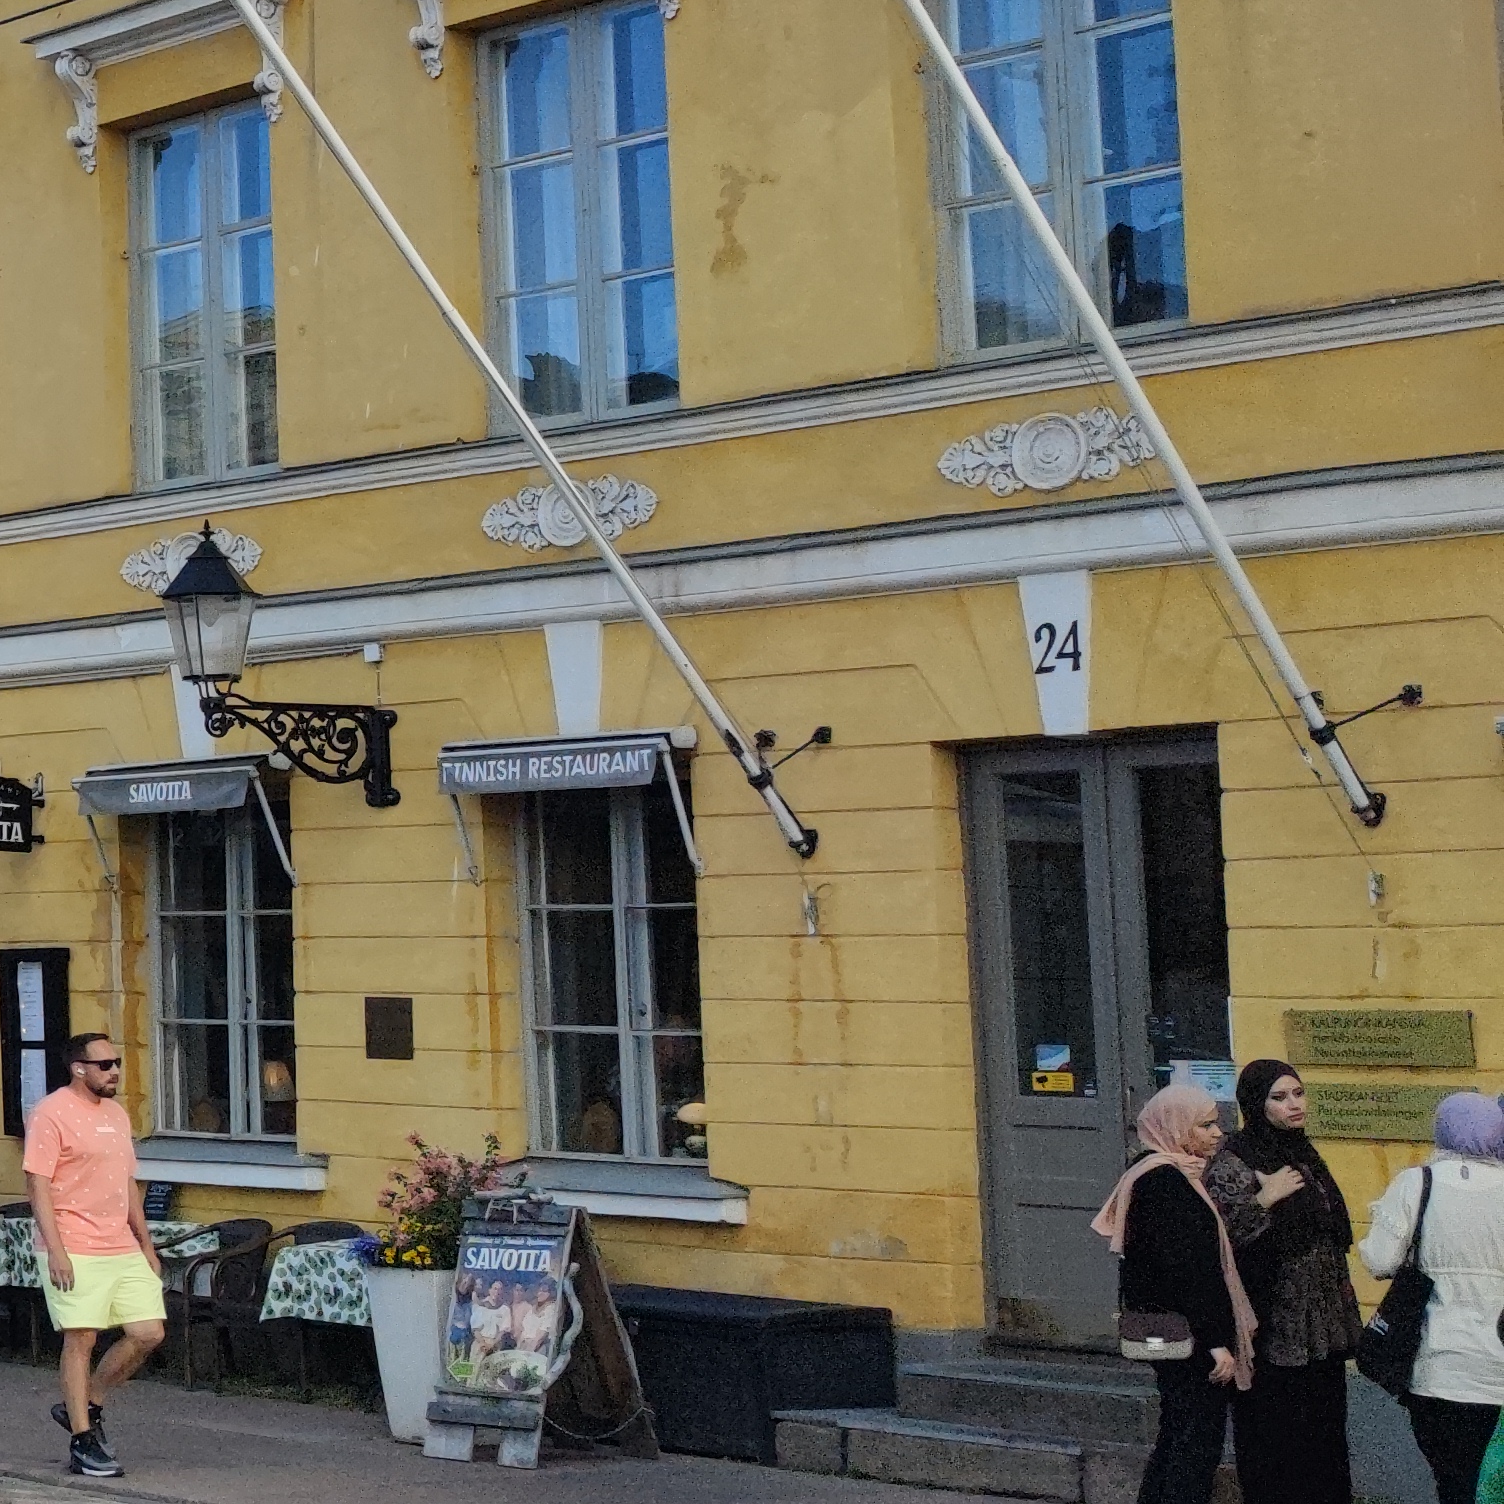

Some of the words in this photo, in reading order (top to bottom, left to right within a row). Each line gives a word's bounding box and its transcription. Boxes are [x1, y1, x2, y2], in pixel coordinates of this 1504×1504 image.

[1034, 620, 1082, 674] 24
[442, 759, 521, 785] FINNISH
[528, 749, 652, 780] RESTAURANT
[129, 780, 193, 804] SAVOTTA
[464, 1247, 553, 1272] SAVOTTA
